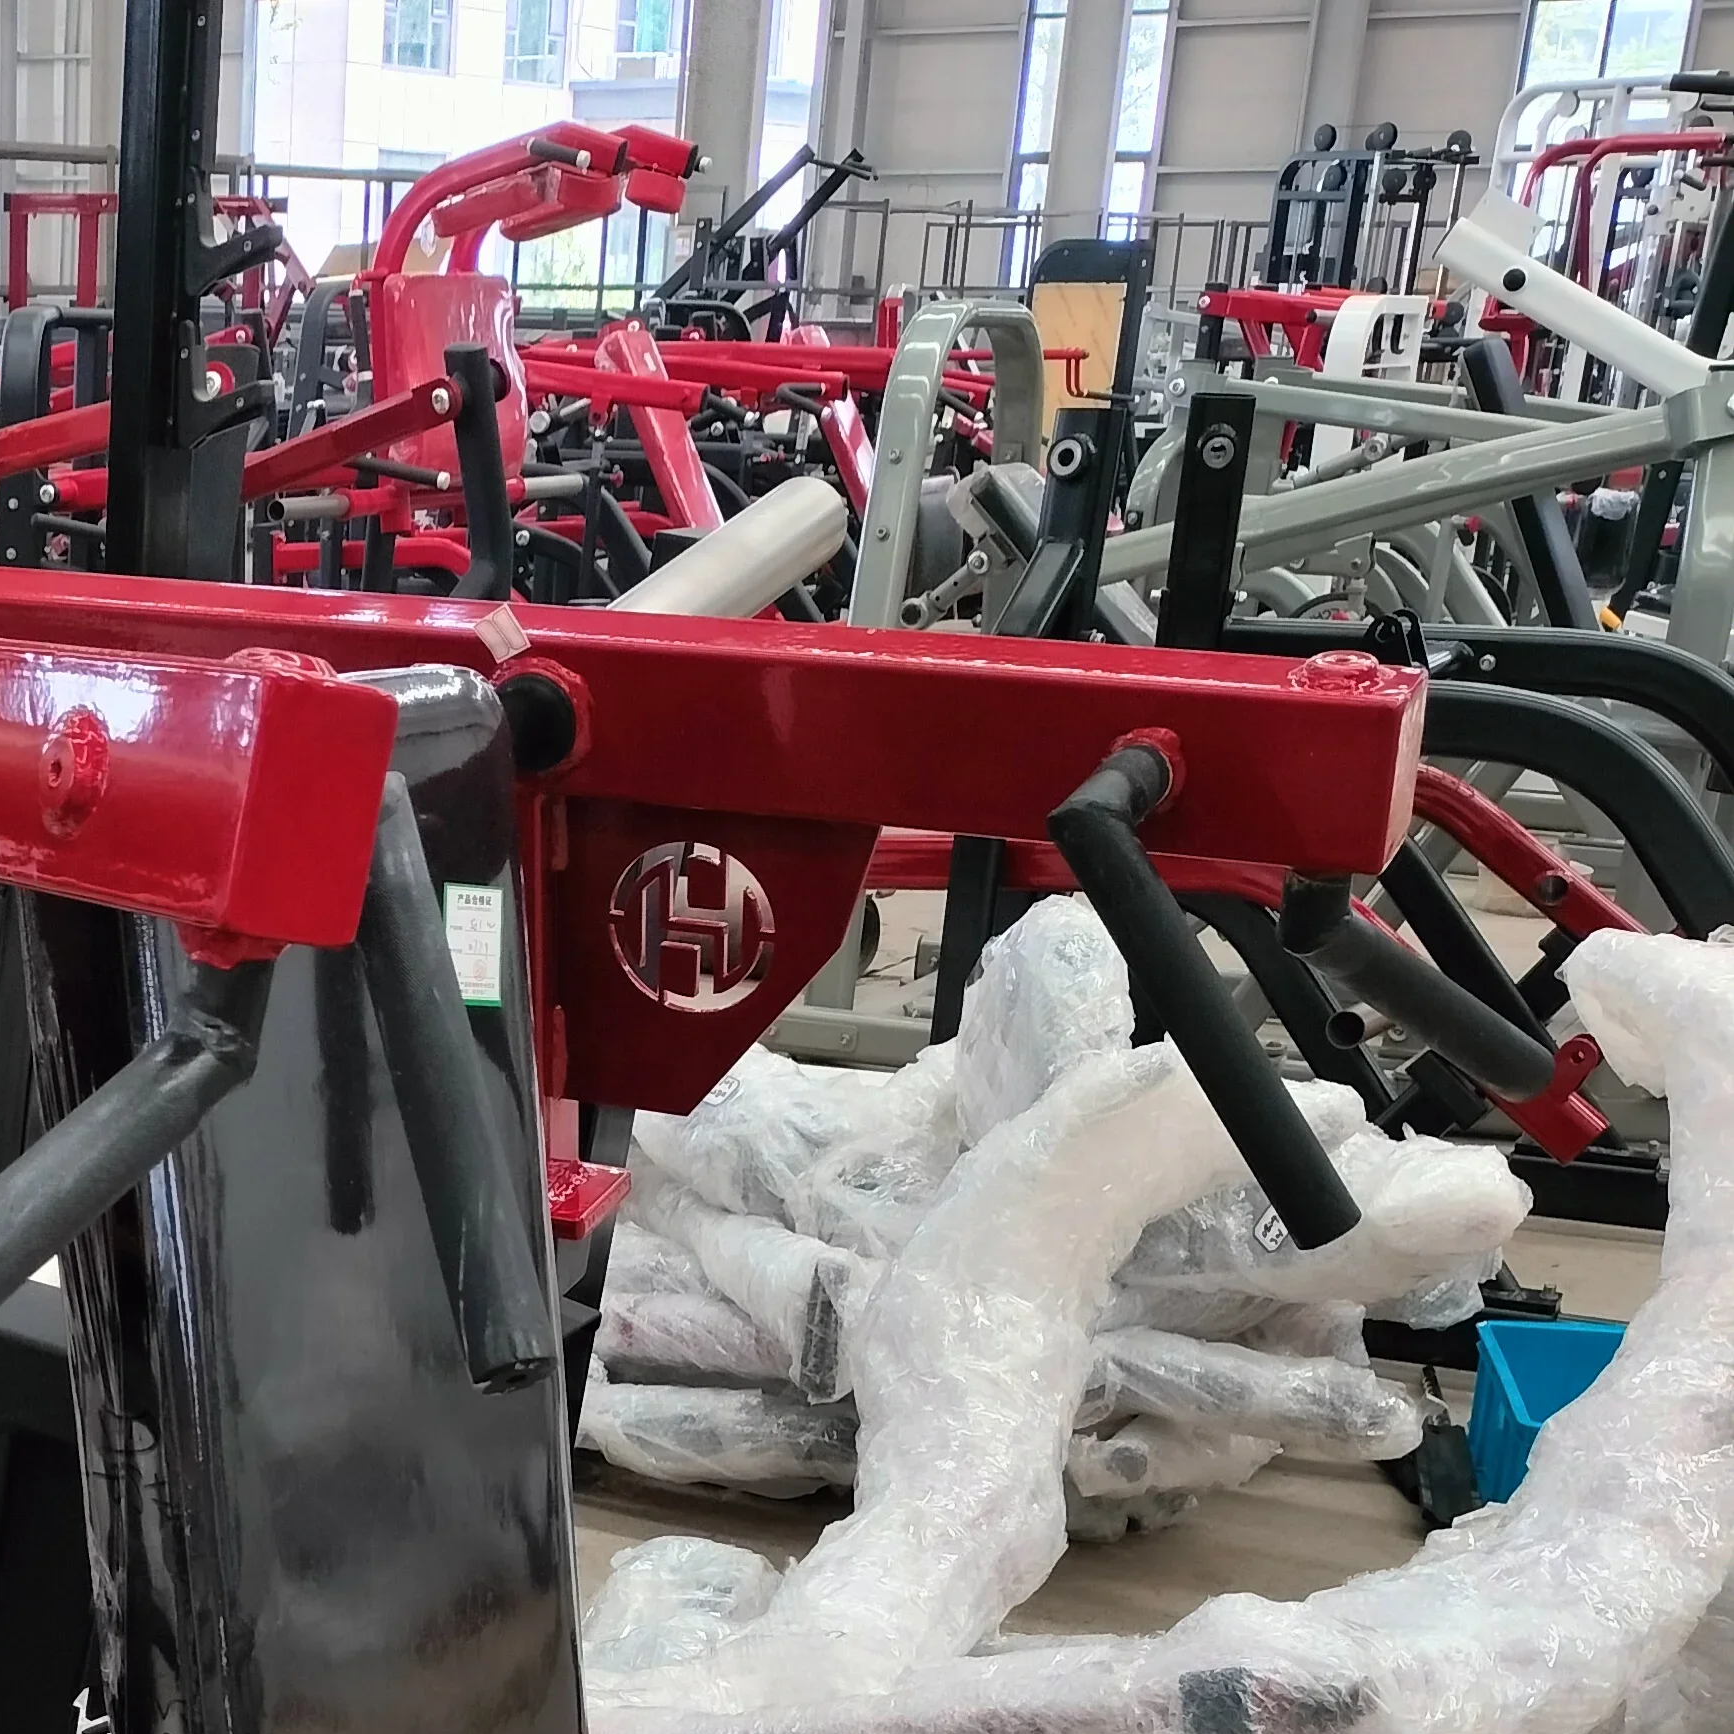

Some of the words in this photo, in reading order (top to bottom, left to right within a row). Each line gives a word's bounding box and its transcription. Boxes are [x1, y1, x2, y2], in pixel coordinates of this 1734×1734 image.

[457, 893, 493, 905] 产品合格证
